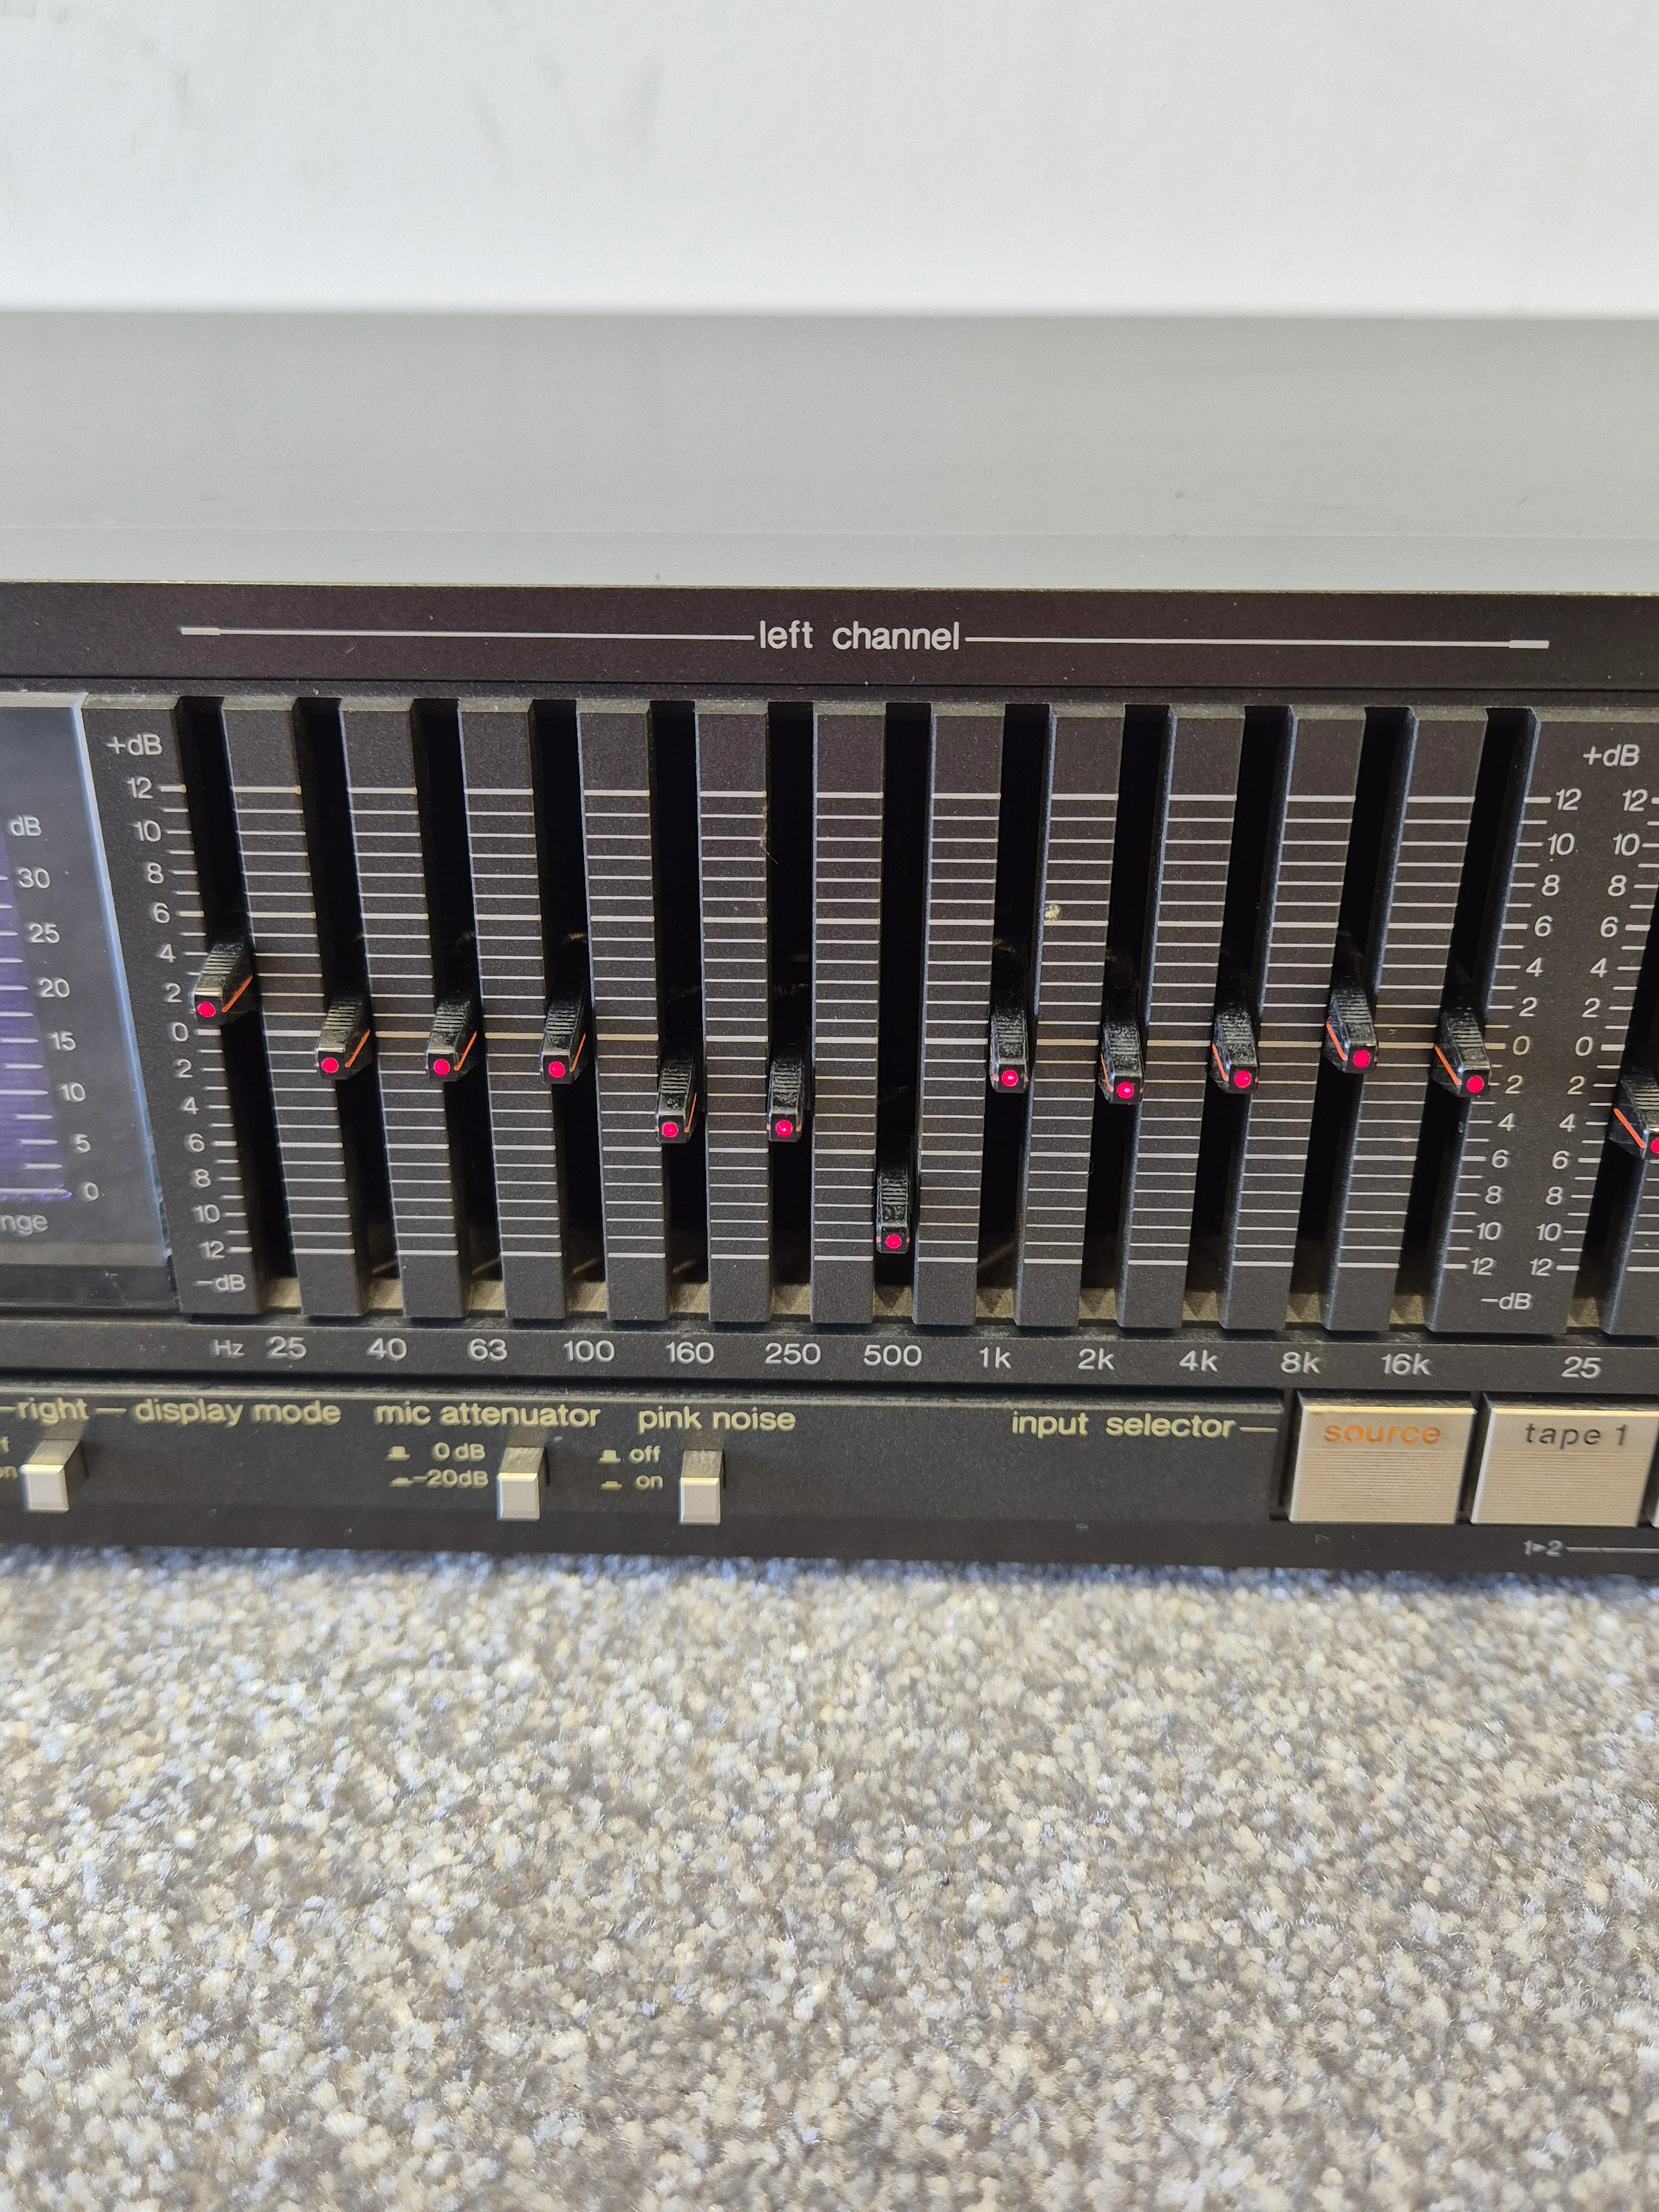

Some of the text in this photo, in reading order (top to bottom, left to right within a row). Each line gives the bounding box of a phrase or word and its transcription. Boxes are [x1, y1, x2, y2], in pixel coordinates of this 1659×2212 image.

[760, 620, 959, 650] left channel
[108, 734, 162, 755] +dB
[1583, 745, 1640, 766] +dB
[127, 778, 153, 799] 12
[1556, 788, 1582, 811] 12
[1623, 789, 1648, 811] 12
[10, 816, 41, 836] dB
[135, 821, 161, 842] 10
[1548, 833, 1575, 855] 10
[1613, 833, 1640, 856] 10
[18, 867, 50, 889] 30
[147, 863, 164, 884] 8
[1541, 874, 1560, 896] 8
[1608, 875, 1626, 896] 8
[154, 904, 169, 924] 6
[29, 922, 60, 943] 25
[1534, 915, 1553, 936] 6
[1600, 916, 1619, 937] 6
[160, 944, 176, 963] 4
[1526, 957, 1543, 977] 4
[1590, 958, 1607, 978] 4
[38, 978, 70, 998] 20
[166, 983, 181, 1003] 2
[1519, 997, 1537, 1016] 2
[1582, 998, 1600, 1018] 2
[50, 1031, 76, 1050] 15
[172, 1022, 189, 1041] 0
[1512, 1036, 1531, 1055] 0
[1575, 1036, 1593, 1056] 0
[176, 1058, 192, 1078] 2
[60, 1082, 86, 1101] 10
[1505, 1075, 1524, 1094] 2
[1567, 1076, 1585, 1095] 2
[184, 1097, 199, 1114] 4
[1498, 1113, 1515, 1131] 4
[1558, 1114, 1576, 1132] 4
[72, 1134, 91, 1153] 5
[185, 1133, 205, 1152] 6
[1491, 1149, 1510, 1168] 6
[1552, 1150, 1569, 1169] 6
[191, 1168, 211, 1188] 8
[79, 1181, 99, 1202] 0
[1484, 1186, 1503, 1204] 8
[1545, 1186, 1563, 1206] 8
[194, 1204, 220, 1223] 10
[1476, 1222, 1503, 1241] 10
[1536, 1223, 1562, 1241] 10
[201, 1240, 225, 1259] 12
[1470, 1258, 1494, 1275] 12
[1529, 1258, 1553, 1276] 12
[210, 1336, 1432, 1376] Hz 25 40 63 100 160 250 500 1k 2k 4k 8k 16k
[1561, 1356, 1601, 1379] 25
[17, 1396, 89, 1426] right
[133, 1398, 341, 1427] display mode
[376, 1401, 601, 1428] mic attenuator
[638, 1406, 796, 1434] pink noise
[1011, 1411, 1235, 1438] input selector
[1322, 1422, 1441, 1444] source
[1524, 1422, 1628, 1449] tape 1
[629, 1445, 660, 1464] off
[635, 1475, 663, 1490] on
